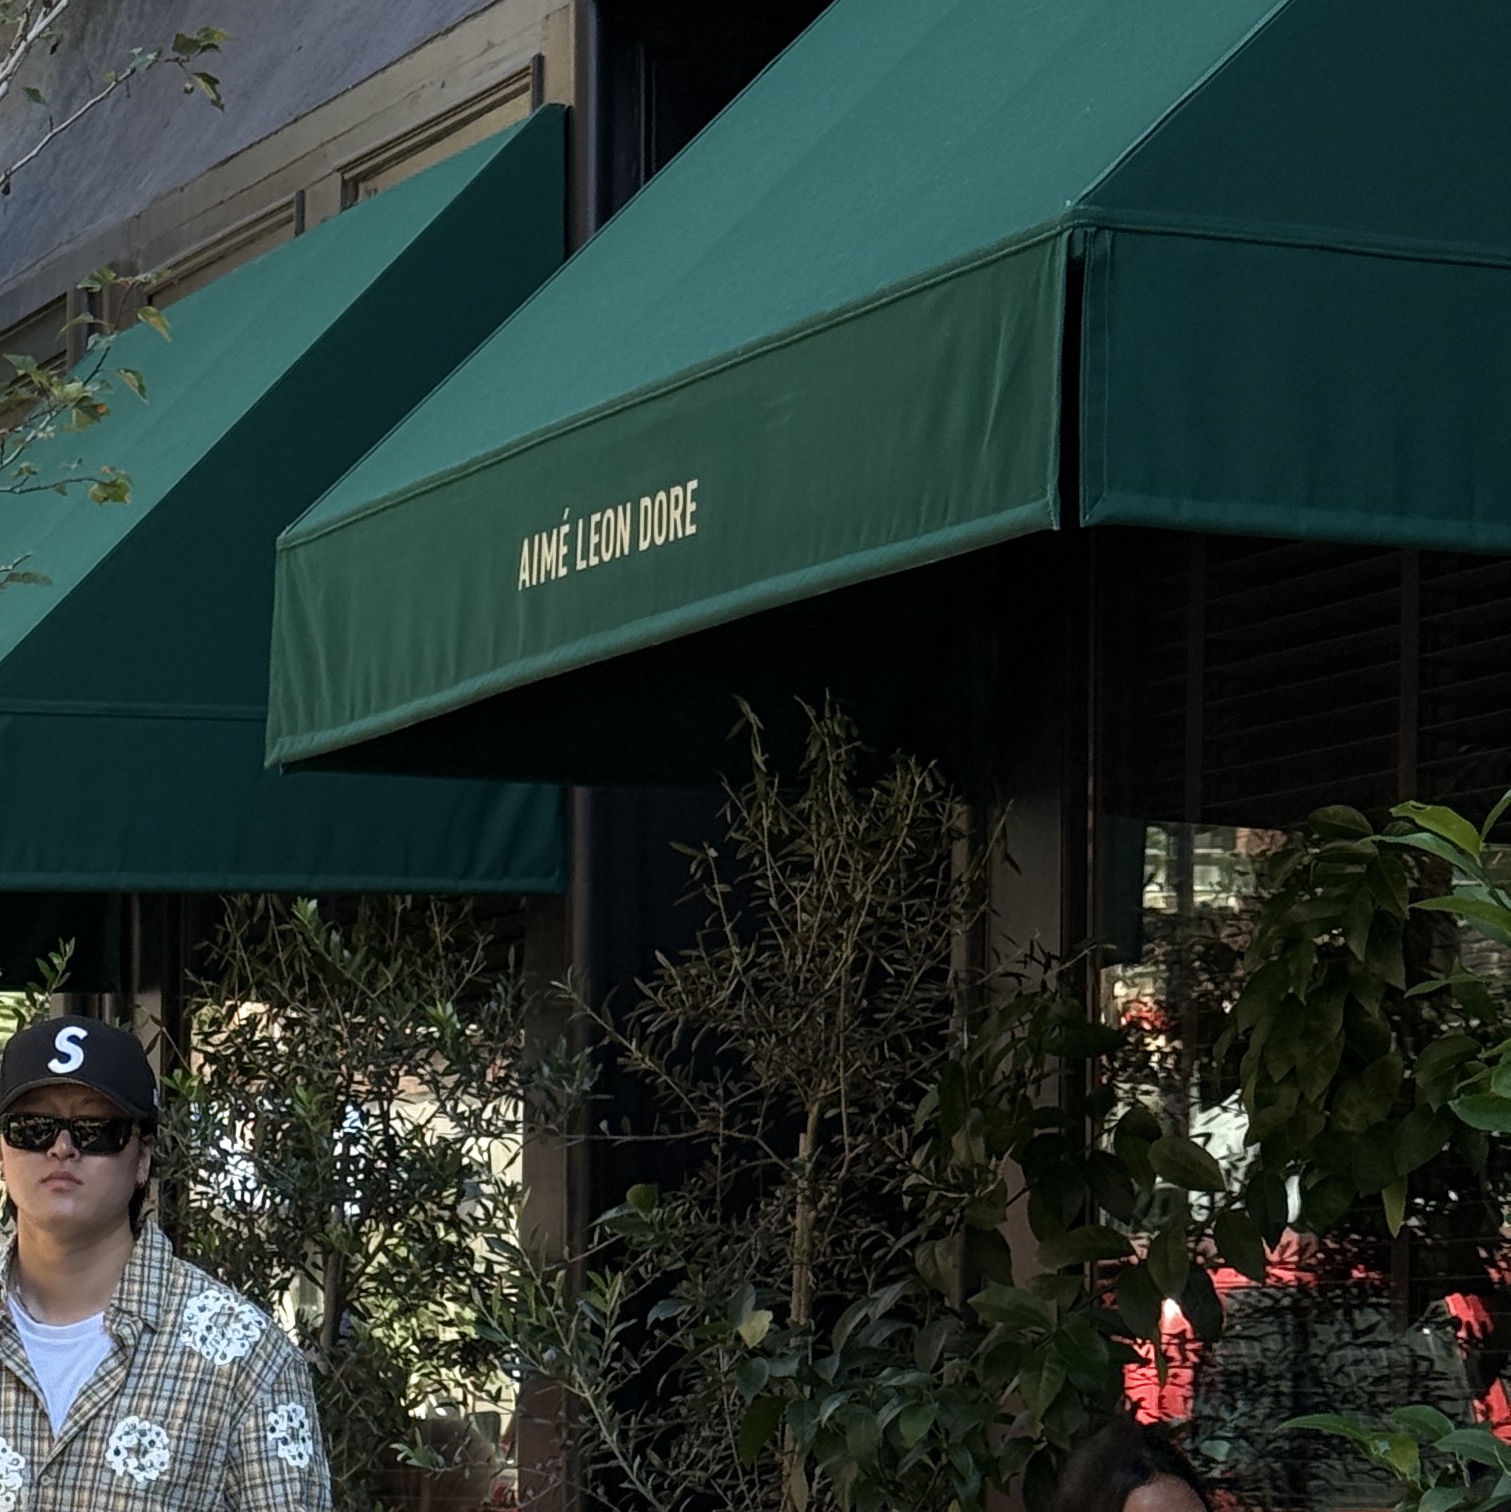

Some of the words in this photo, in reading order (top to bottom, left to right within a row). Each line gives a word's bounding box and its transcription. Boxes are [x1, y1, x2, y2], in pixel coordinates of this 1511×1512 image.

[518, 506, 570, 591] AIMÉ
[575, 502, 632, 571] LEON
[638, 479, 698, 552] DORE
[47, 1025, 89, 1075] S
